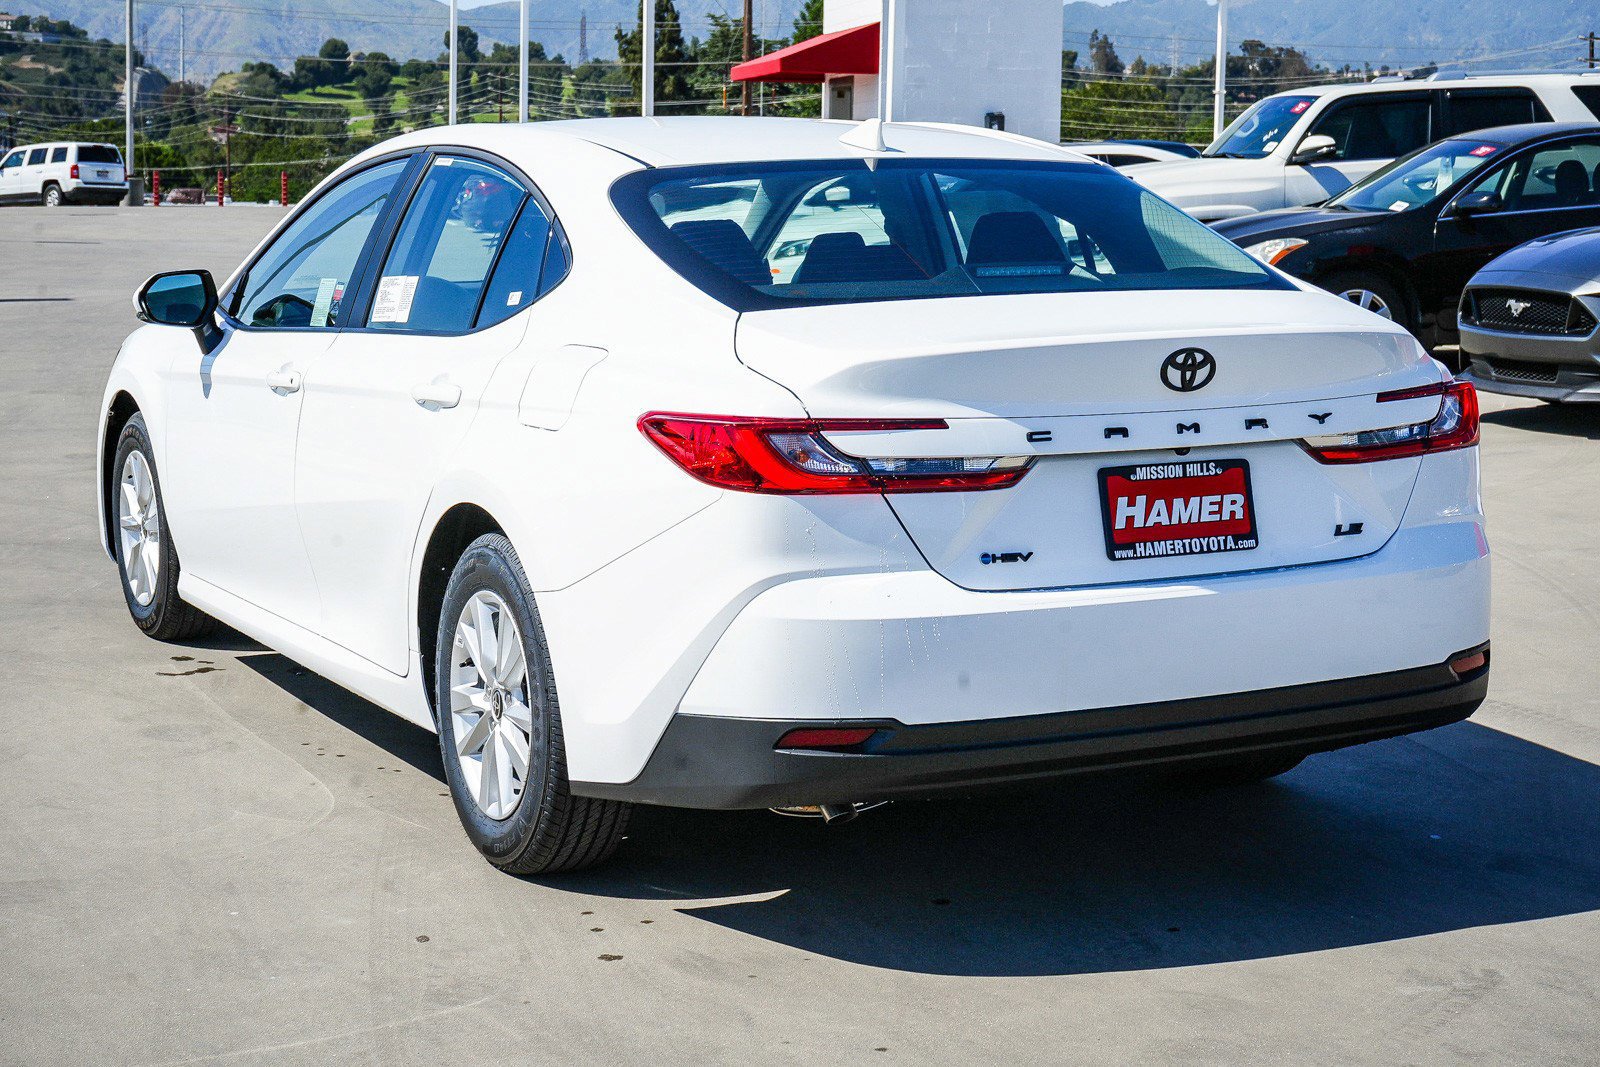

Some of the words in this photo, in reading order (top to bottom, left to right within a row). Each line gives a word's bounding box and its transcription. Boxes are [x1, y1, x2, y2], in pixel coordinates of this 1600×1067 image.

[1026, 412, 1333, 443] CAMRY
[1136, 463, 1184, 481] MISSION
[1186, 462, 1216, 477] HILLS
[1114, 493, 1245, 530] HAMER
[1333, 522, 1364, 537] LE
[991, 551, 1034, 564] HEV
[1114, 535, 1256, 559] www.HAMERTOYOTA.com
